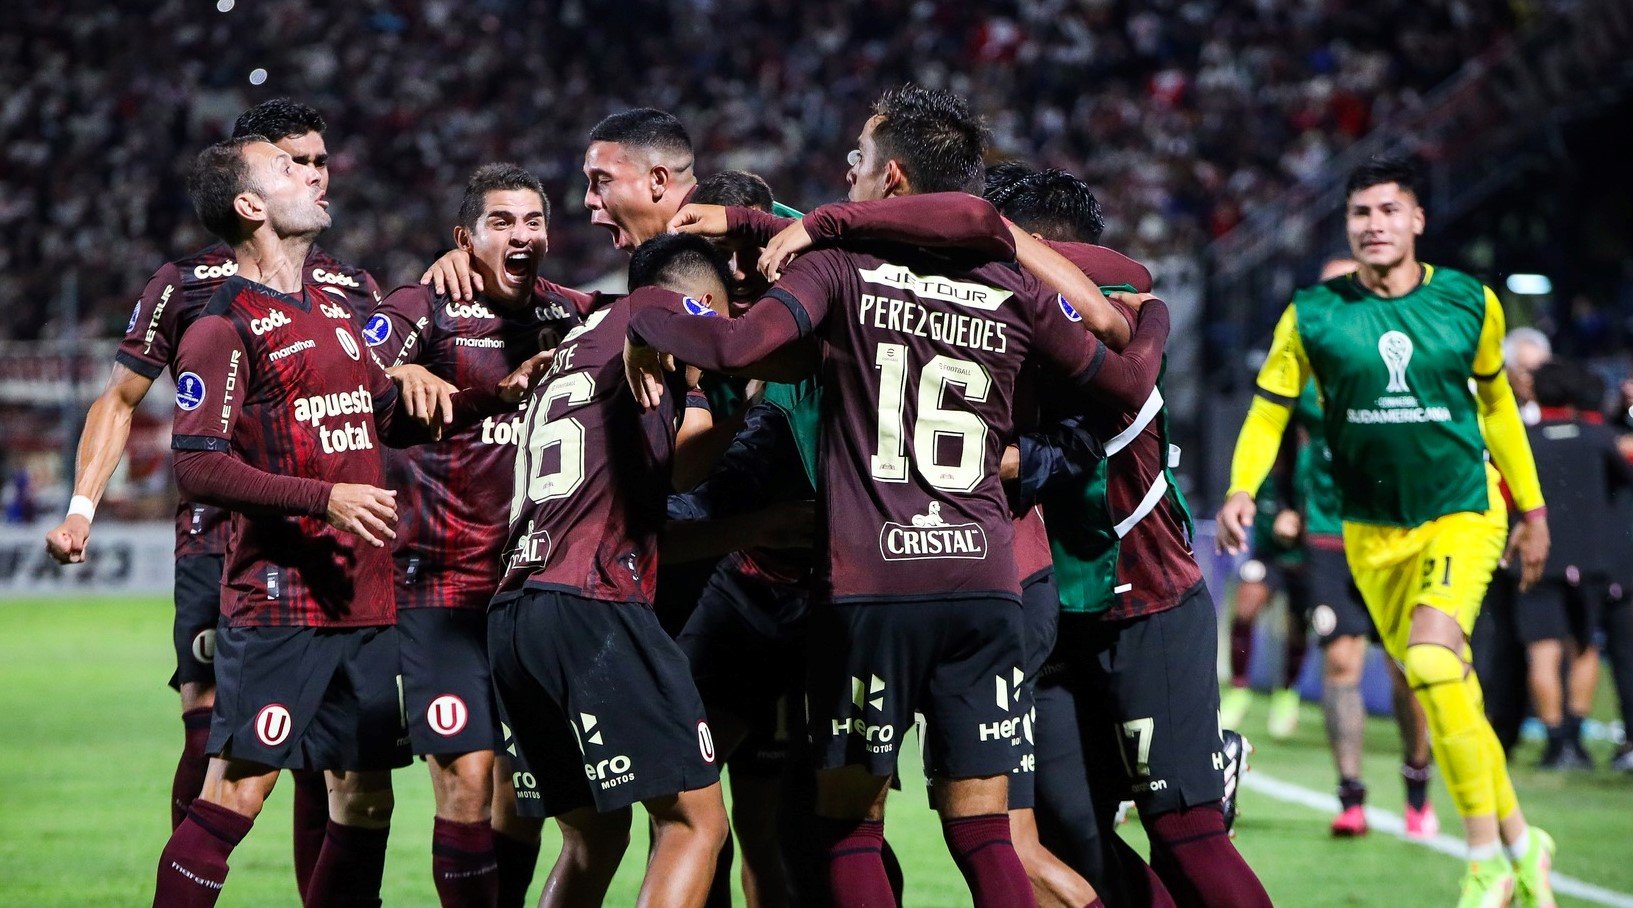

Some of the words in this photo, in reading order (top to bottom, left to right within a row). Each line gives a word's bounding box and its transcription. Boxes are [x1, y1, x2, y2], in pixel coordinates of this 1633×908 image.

[885, 273, 987, 303] JETOUR
[144, 284, 175, 354] JETOUR
[269, 340, 316, 361] marathon
[456, 336, 505, 349] marathon
[222, 350, 242, 433] JETOUR
[871, 342, 993, 493] 16
[320, 421, 373, 454] total
[887, 528, 982, 554] CRISTAL
[264, 711, 287, 742] U
[435, 702, 457, 731] U
[831, 717, 894, 742] Hero
[979, 716, 1021, 742] Her
[517, 791, 541, 800] MOTOS
[601, 773, 635, 790] MOTOS
[171, 861, 224, 889] maratho
